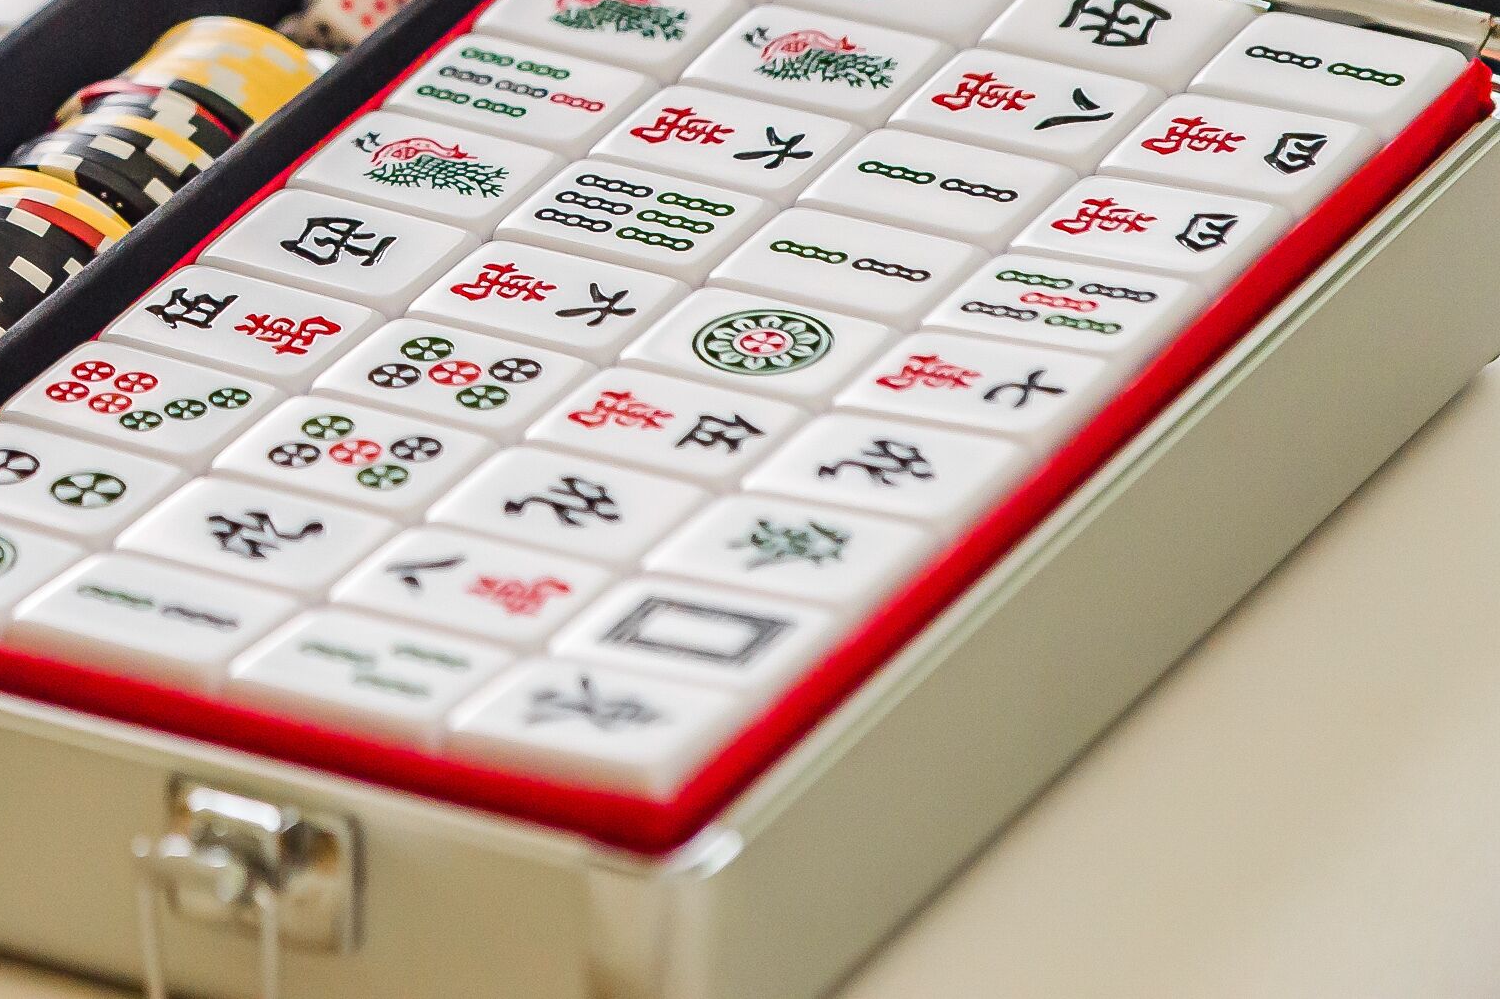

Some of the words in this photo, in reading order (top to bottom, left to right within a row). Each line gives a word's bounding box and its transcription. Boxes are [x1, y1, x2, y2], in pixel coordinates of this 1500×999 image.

[932, 71, 1115, 131] 八萬
[629, 105, 814, 169] 六萬
[1140, 115, 1328, 175] 四萬
[280, 215, 396, 268] 西
[1051, 196, 1238, 253] 四萬
[144, 287, 345, 356] 伍萬
[451, 262, 637, 327] 六萬
[876, 353, 1067, 409] 七萬
[568, 389, 766, 453] 伍萬
[504, 475, 623, 526] 北
[387, 556, 573, 615] 八萬
